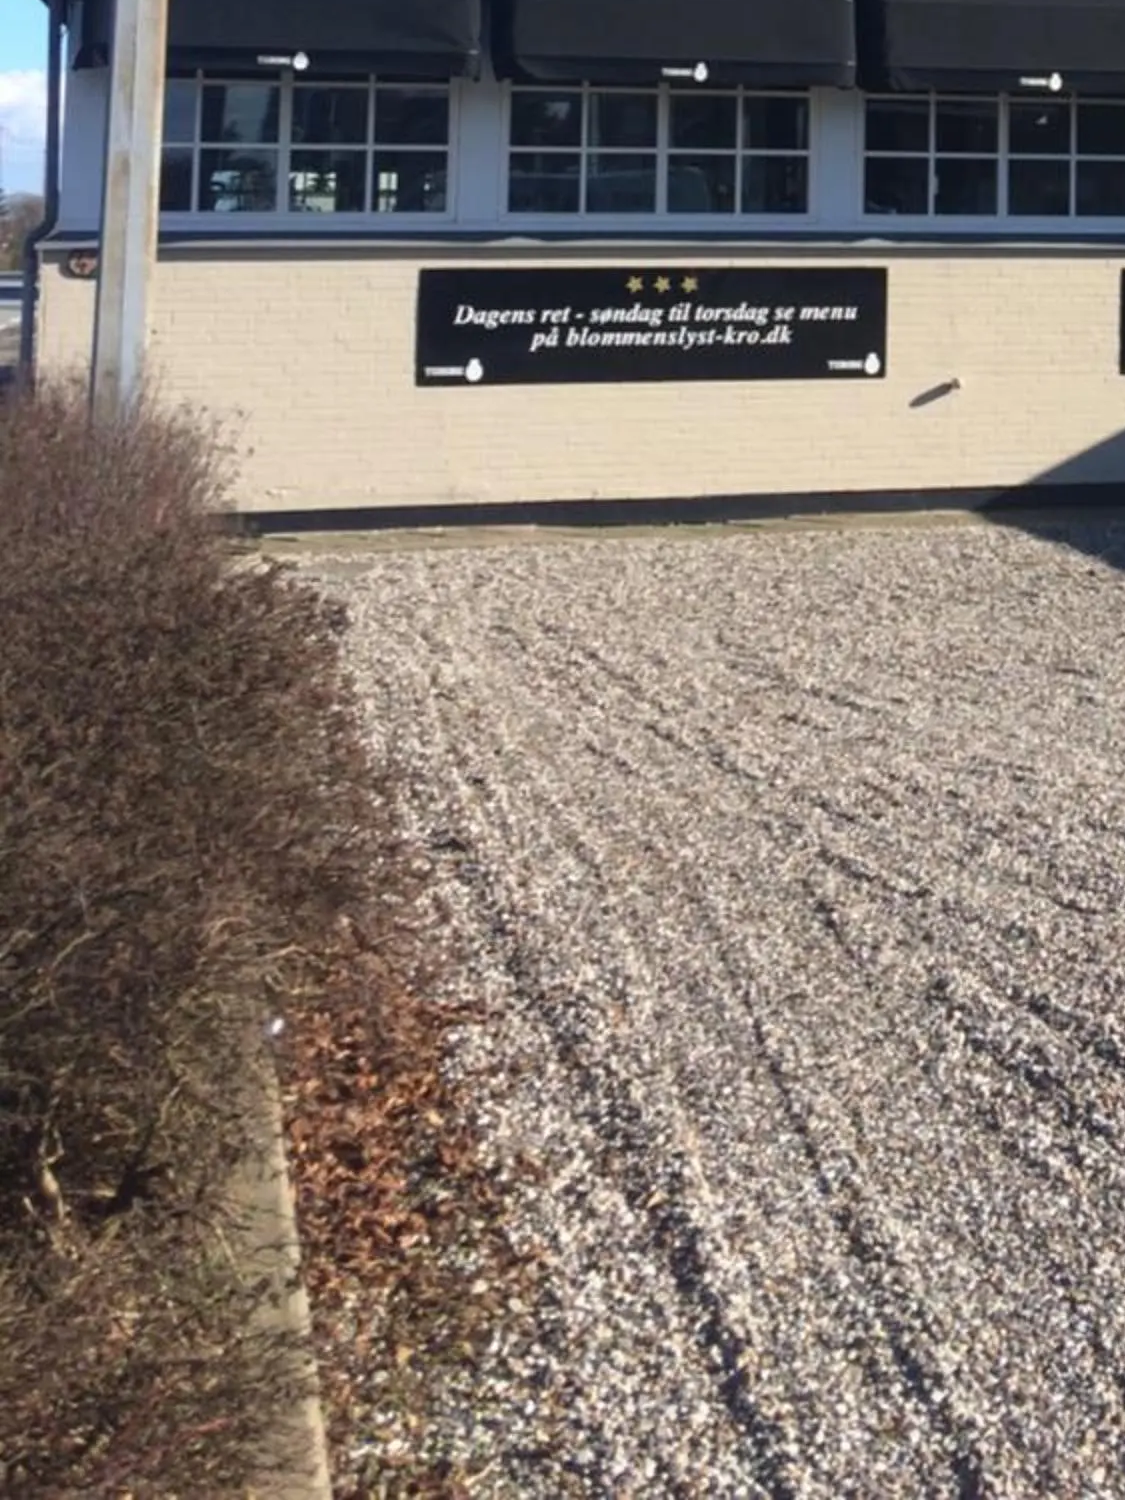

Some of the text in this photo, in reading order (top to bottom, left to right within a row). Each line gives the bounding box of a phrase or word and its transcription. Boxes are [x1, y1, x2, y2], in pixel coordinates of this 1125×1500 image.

[454, 305, 537, 329] Dagens
[540, 307, 571, 323] ret
[588, 303, 664, 328] søndag
[668, 302, 692, 322] til
[694, 302, 770, 326] torsdag
[774, 307, 795, 321] se
[799, 306, 858, 321] menu
[529, 325, 793, 352] på blommenslyst-kro.dk
